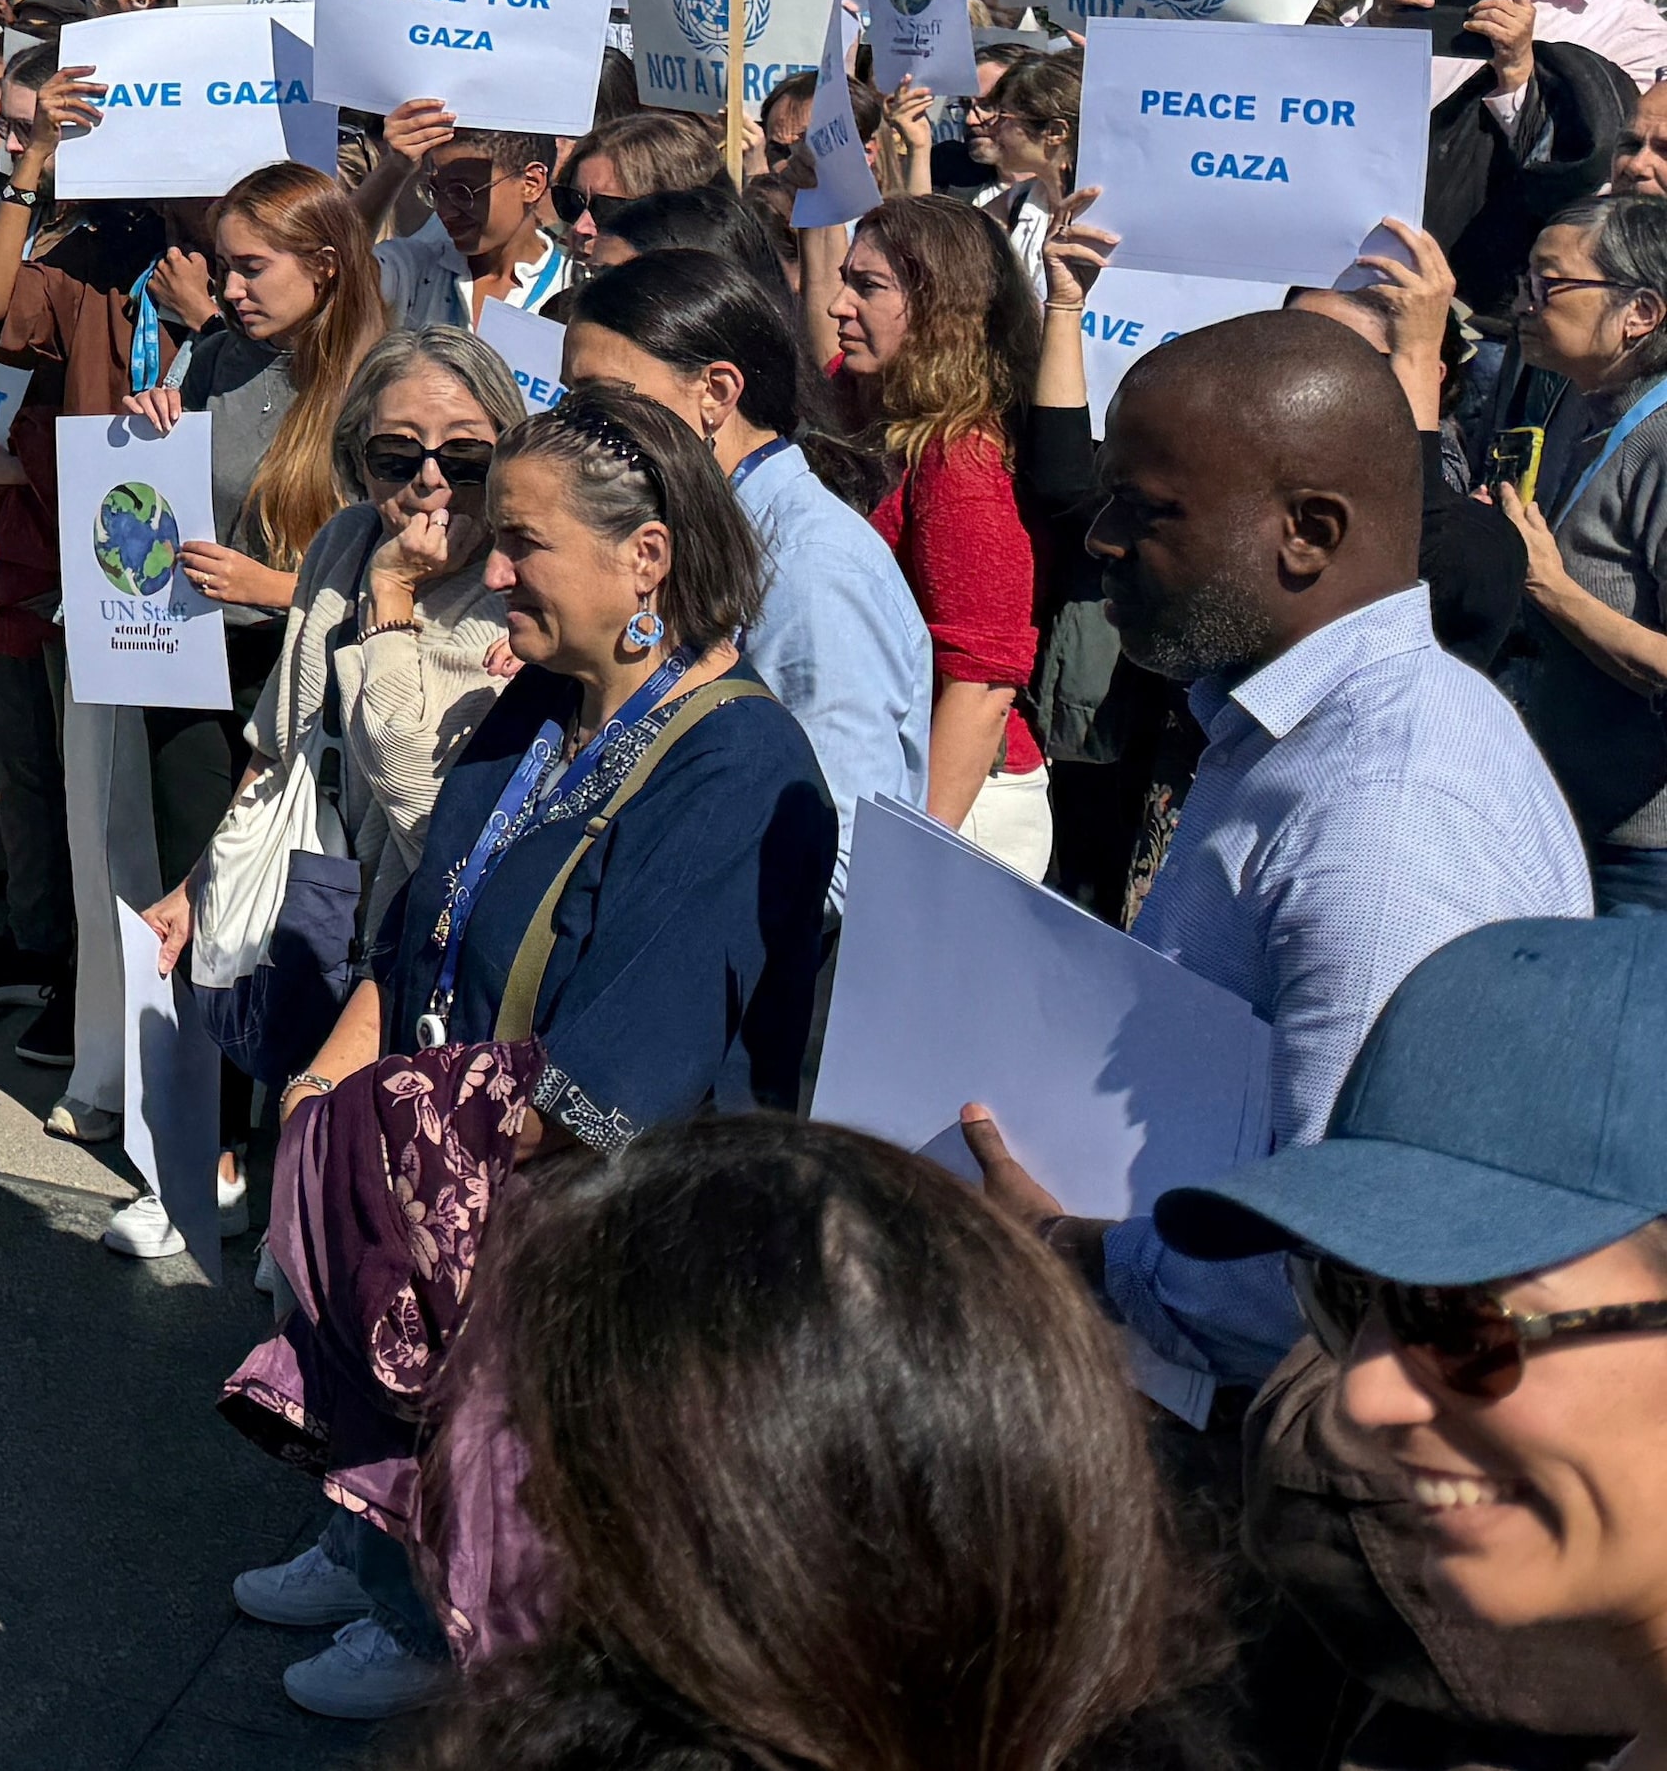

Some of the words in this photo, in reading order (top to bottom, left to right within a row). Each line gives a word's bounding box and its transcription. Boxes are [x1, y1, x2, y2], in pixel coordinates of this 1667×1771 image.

[408, 24, 493, 51] GAZA
[646, 51, 687, 91] NOT
[695, 60, 709, 96] A
[206, 80, 309, 105] GAZA
[1140, 89, 1257, 121] PEACE
[1280, 97, 1356, 127] FOR
[1190, 150, 1289, 183] GAZA
[1081, 309, 1144, 347] AVE
[99, 599, 136, 621] UN
[141, 600, 188, 622] Staff
[114, 622, 151, 636] stand
[152, 622, 173, 638] for
[110, 637, 179, 654] humanity!
